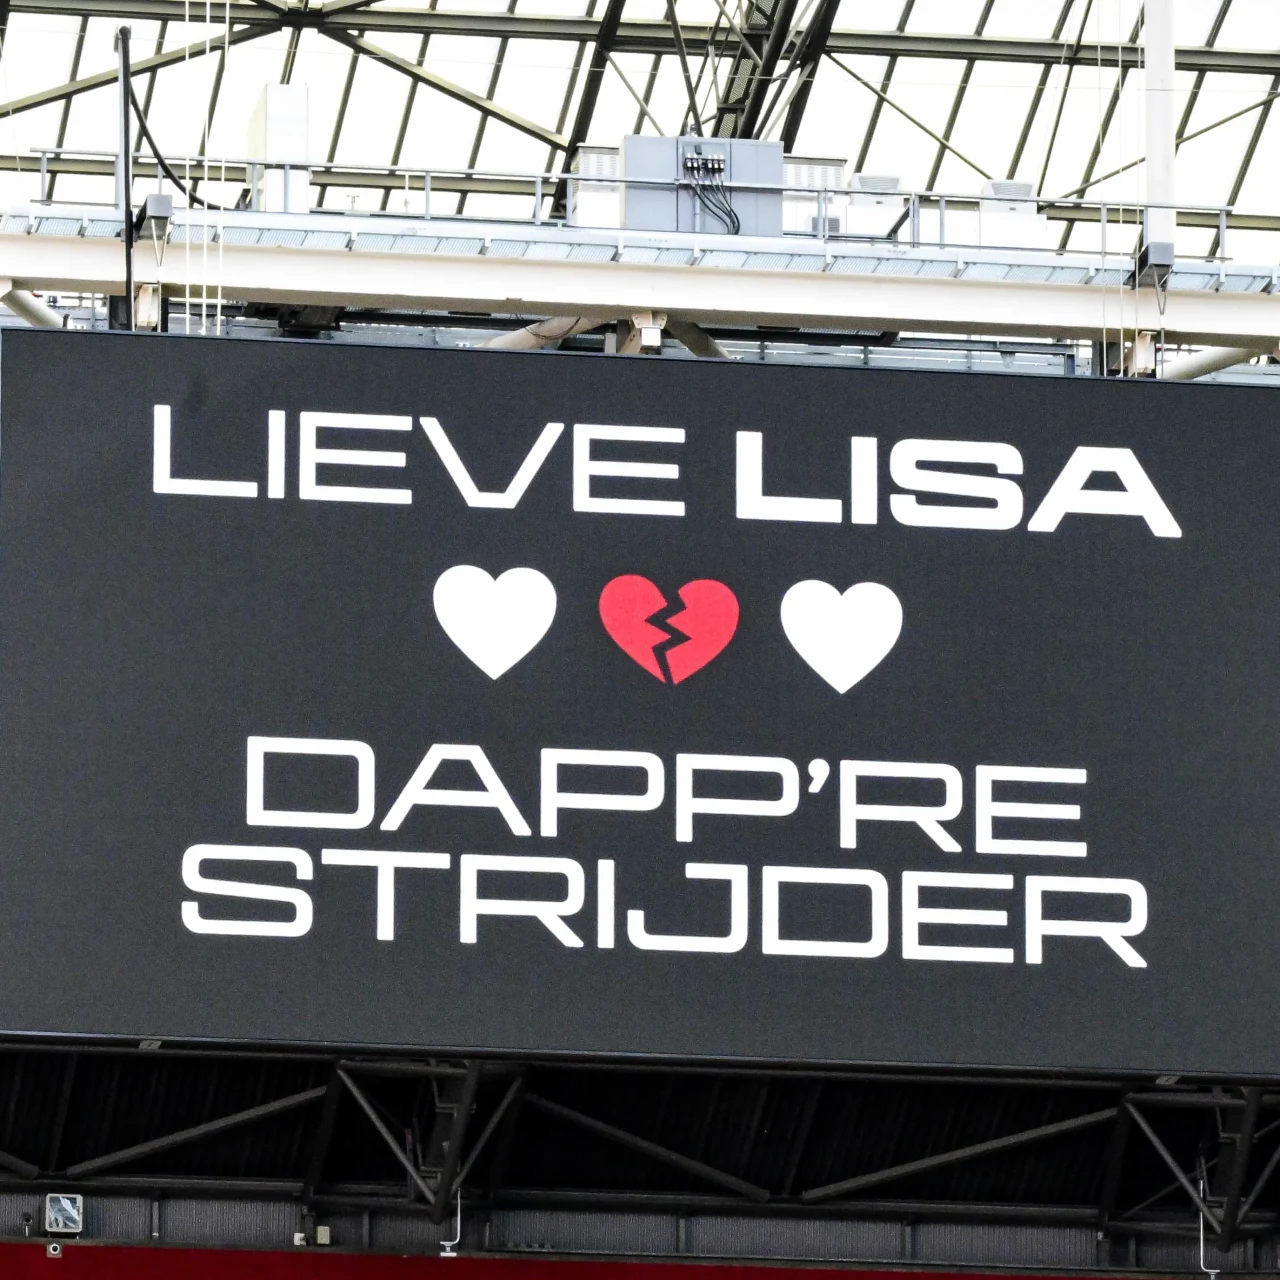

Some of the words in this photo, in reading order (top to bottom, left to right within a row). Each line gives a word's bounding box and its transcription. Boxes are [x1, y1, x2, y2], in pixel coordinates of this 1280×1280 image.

[153, 405, 687, 517] LIEVE
[736, 430, 1183, 539] LISA
[246, 735, 1088, 859] DAPP'RE
[181, 844, 1148, 969] STRIJDER
